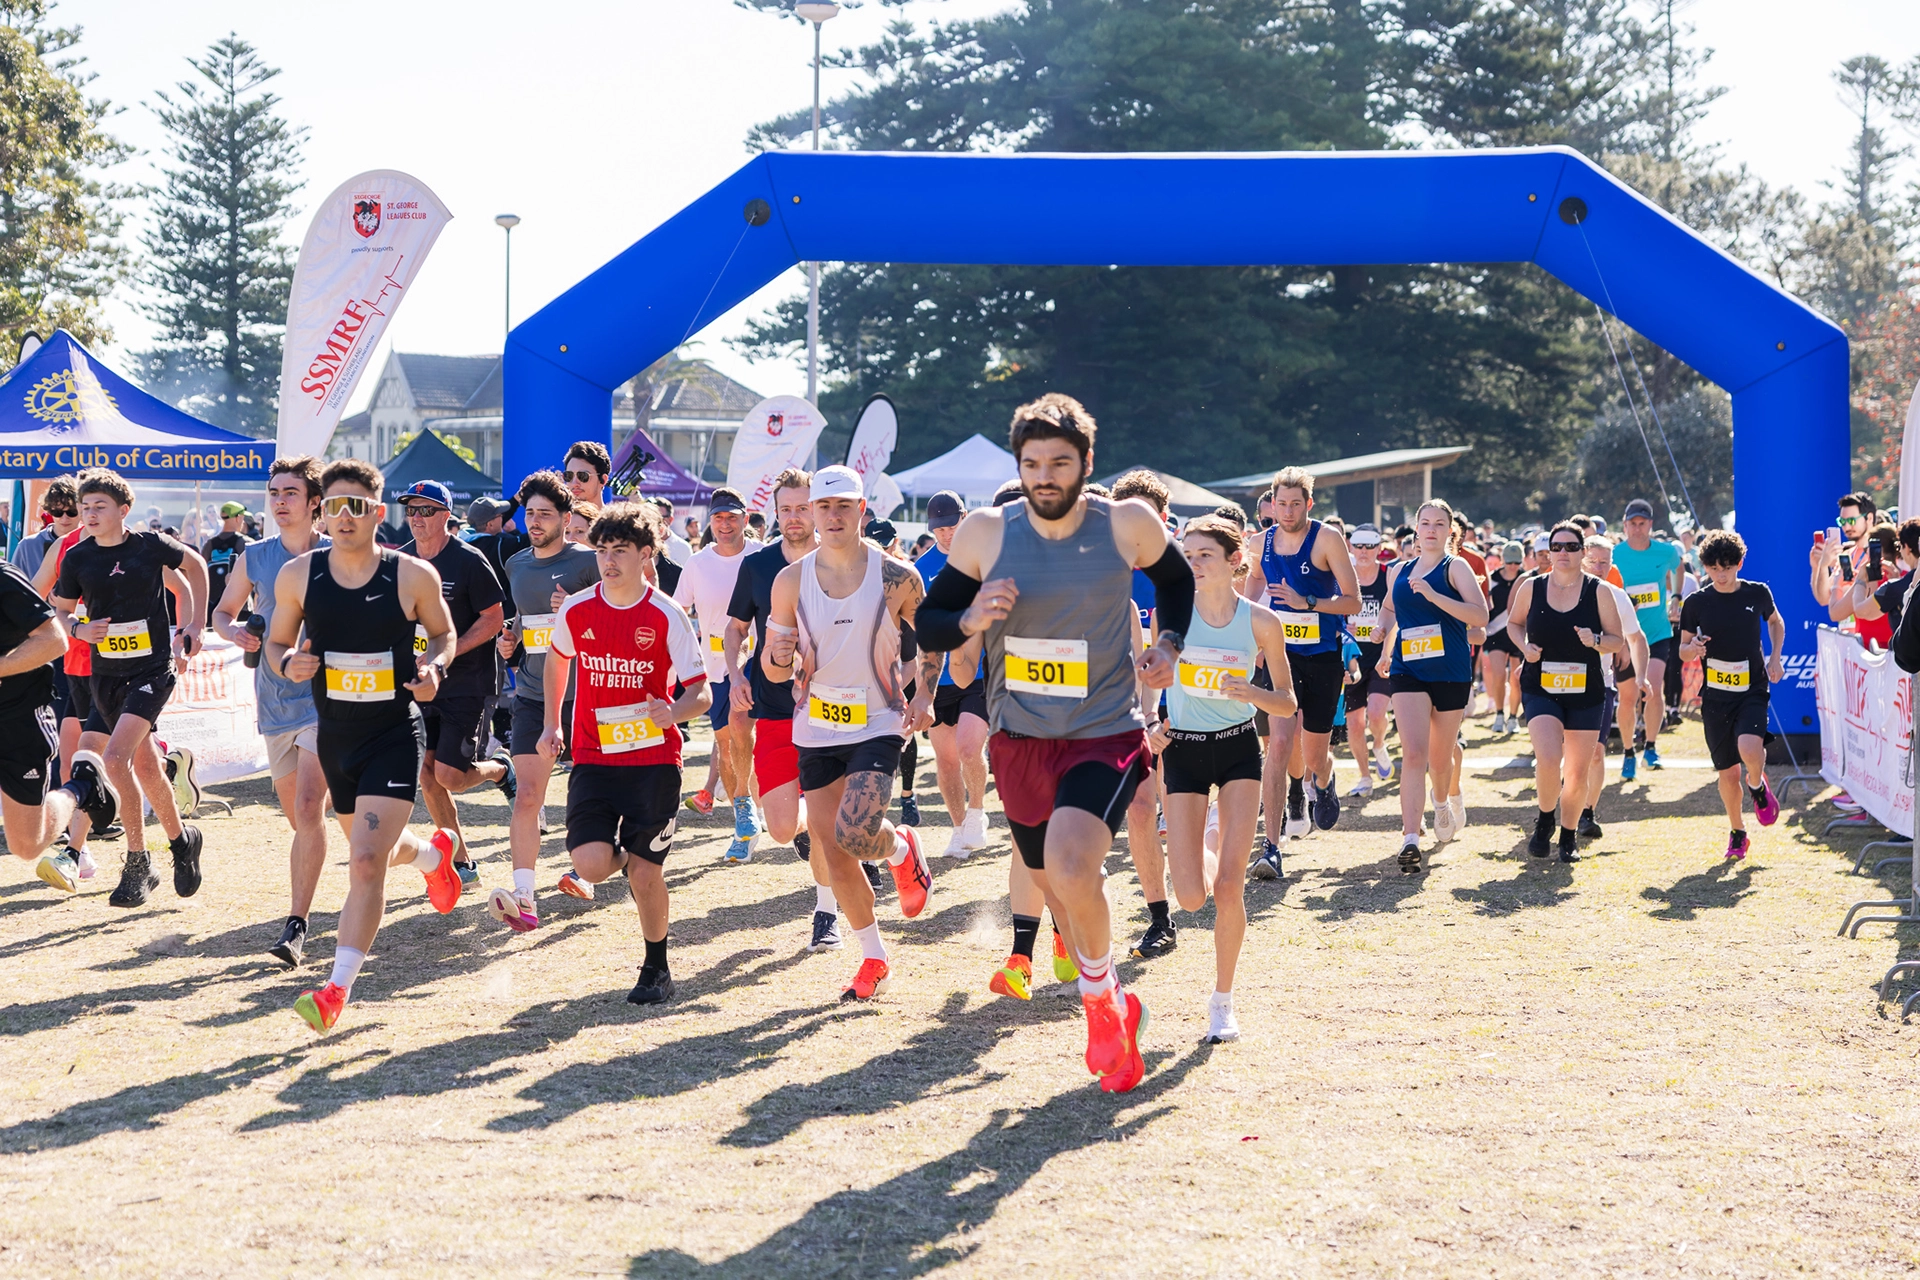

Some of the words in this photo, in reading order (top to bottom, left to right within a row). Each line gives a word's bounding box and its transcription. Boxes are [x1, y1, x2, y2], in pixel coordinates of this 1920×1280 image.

[386, 212, 411, 220] LEAGUES
[411, 211, 427, 220] CLUB
[351, 246, 371, 254] proudly
[371, 245, 394, 253] supports
[300, 299, 367, 401] SSMRF
[357, 334, 375, 365] FOUNDATION
[343, 347, 363, 377] SUTHERLAND
[0, 451, 50, 471] tary
[55, 447, 110, 469] Club
[116, 447, 140, 468] of
[145, 448, 263, 473] Caringbah
[1285, 625, 1309, 638] 587
[109, 636, 139, 651] 505
[1410, 638, 1433, 654] 672
[366, 658, 383, 666] DASH
[580, 651, 655, 675] Emirates
[1222, 655, 1239, 663] DASH
[590, 671, 605, 687] FLY
[607, 673, 644, 689] BETTER
[1027, 661, 1065, 684] 501
[1553, 674, 1574, 688] 671
[1716, 671, 1741, 686] 543
[341, 672, 378, 692] 673
[821, 702, 852, 723] 539
[612, 721, 648, 744] 633
[1184, 732, 1207, 742] PRO
[1215, 727, 1240, 741] NIKE
